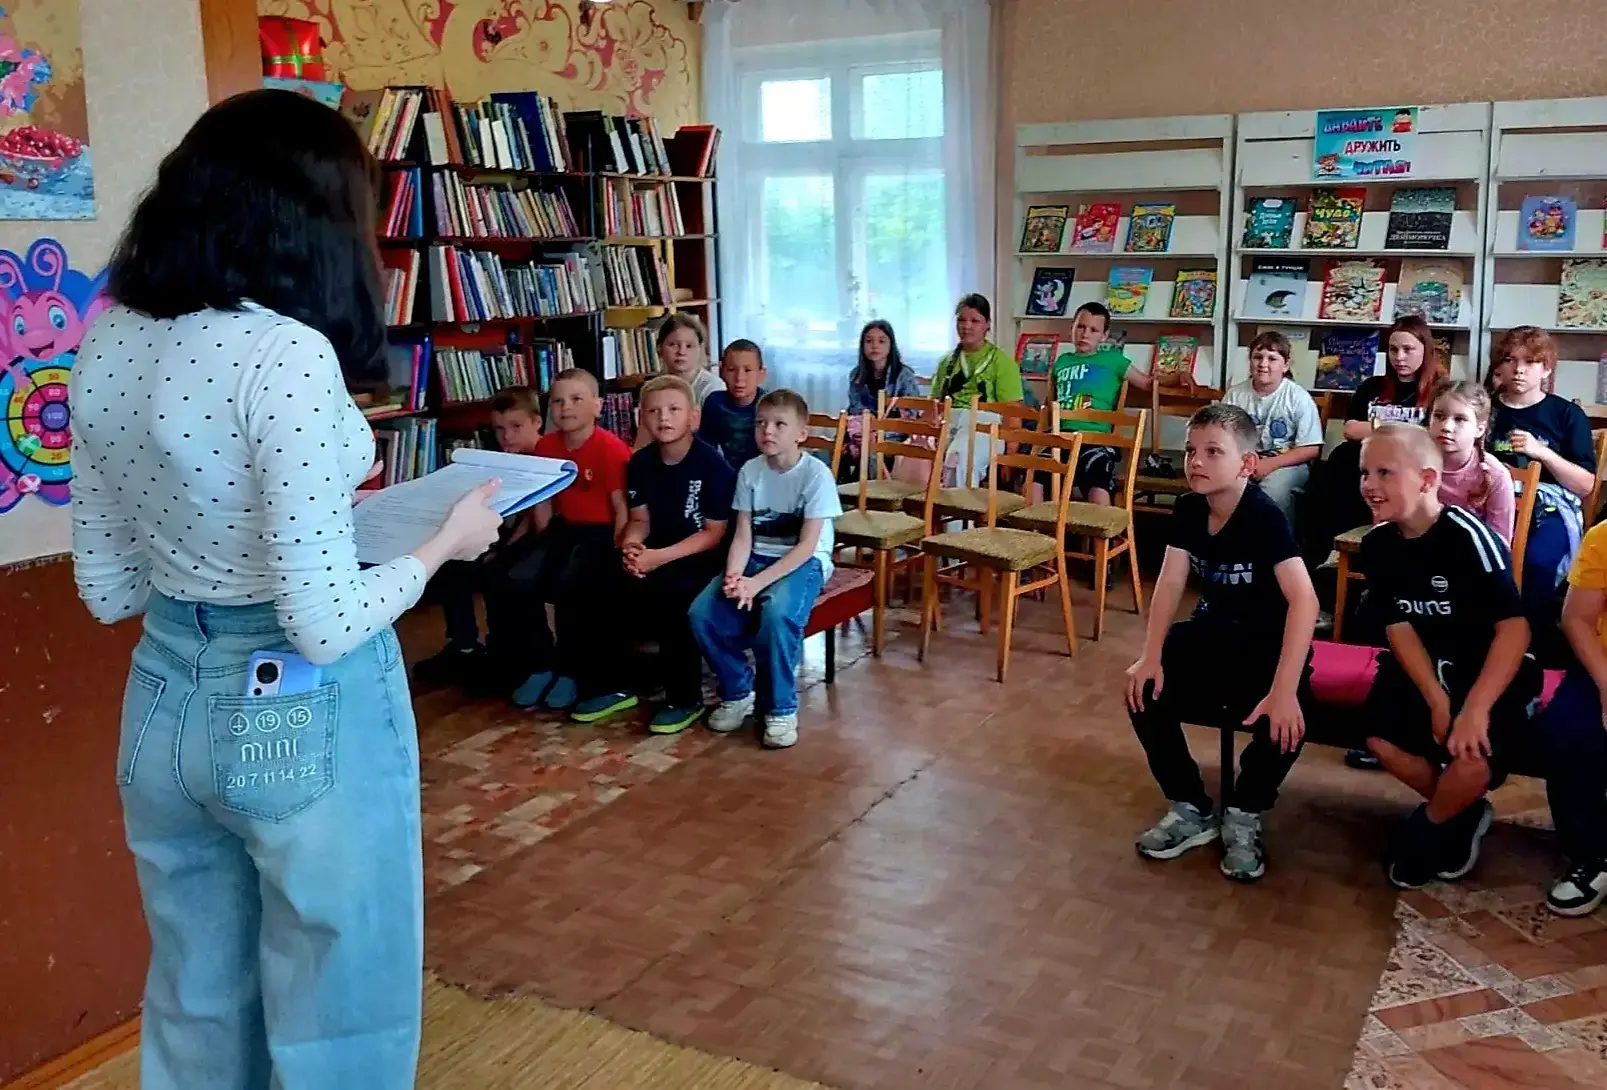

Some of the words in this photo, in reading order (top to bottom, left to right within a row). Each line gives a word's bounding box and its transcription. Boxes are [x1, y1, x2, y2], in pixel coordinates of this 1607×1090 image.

[1344, 139, 1401, 154] ДРУЖИТЬ
[260, 714, 276, 728] 19
[291, 710, 307, 724] 15
